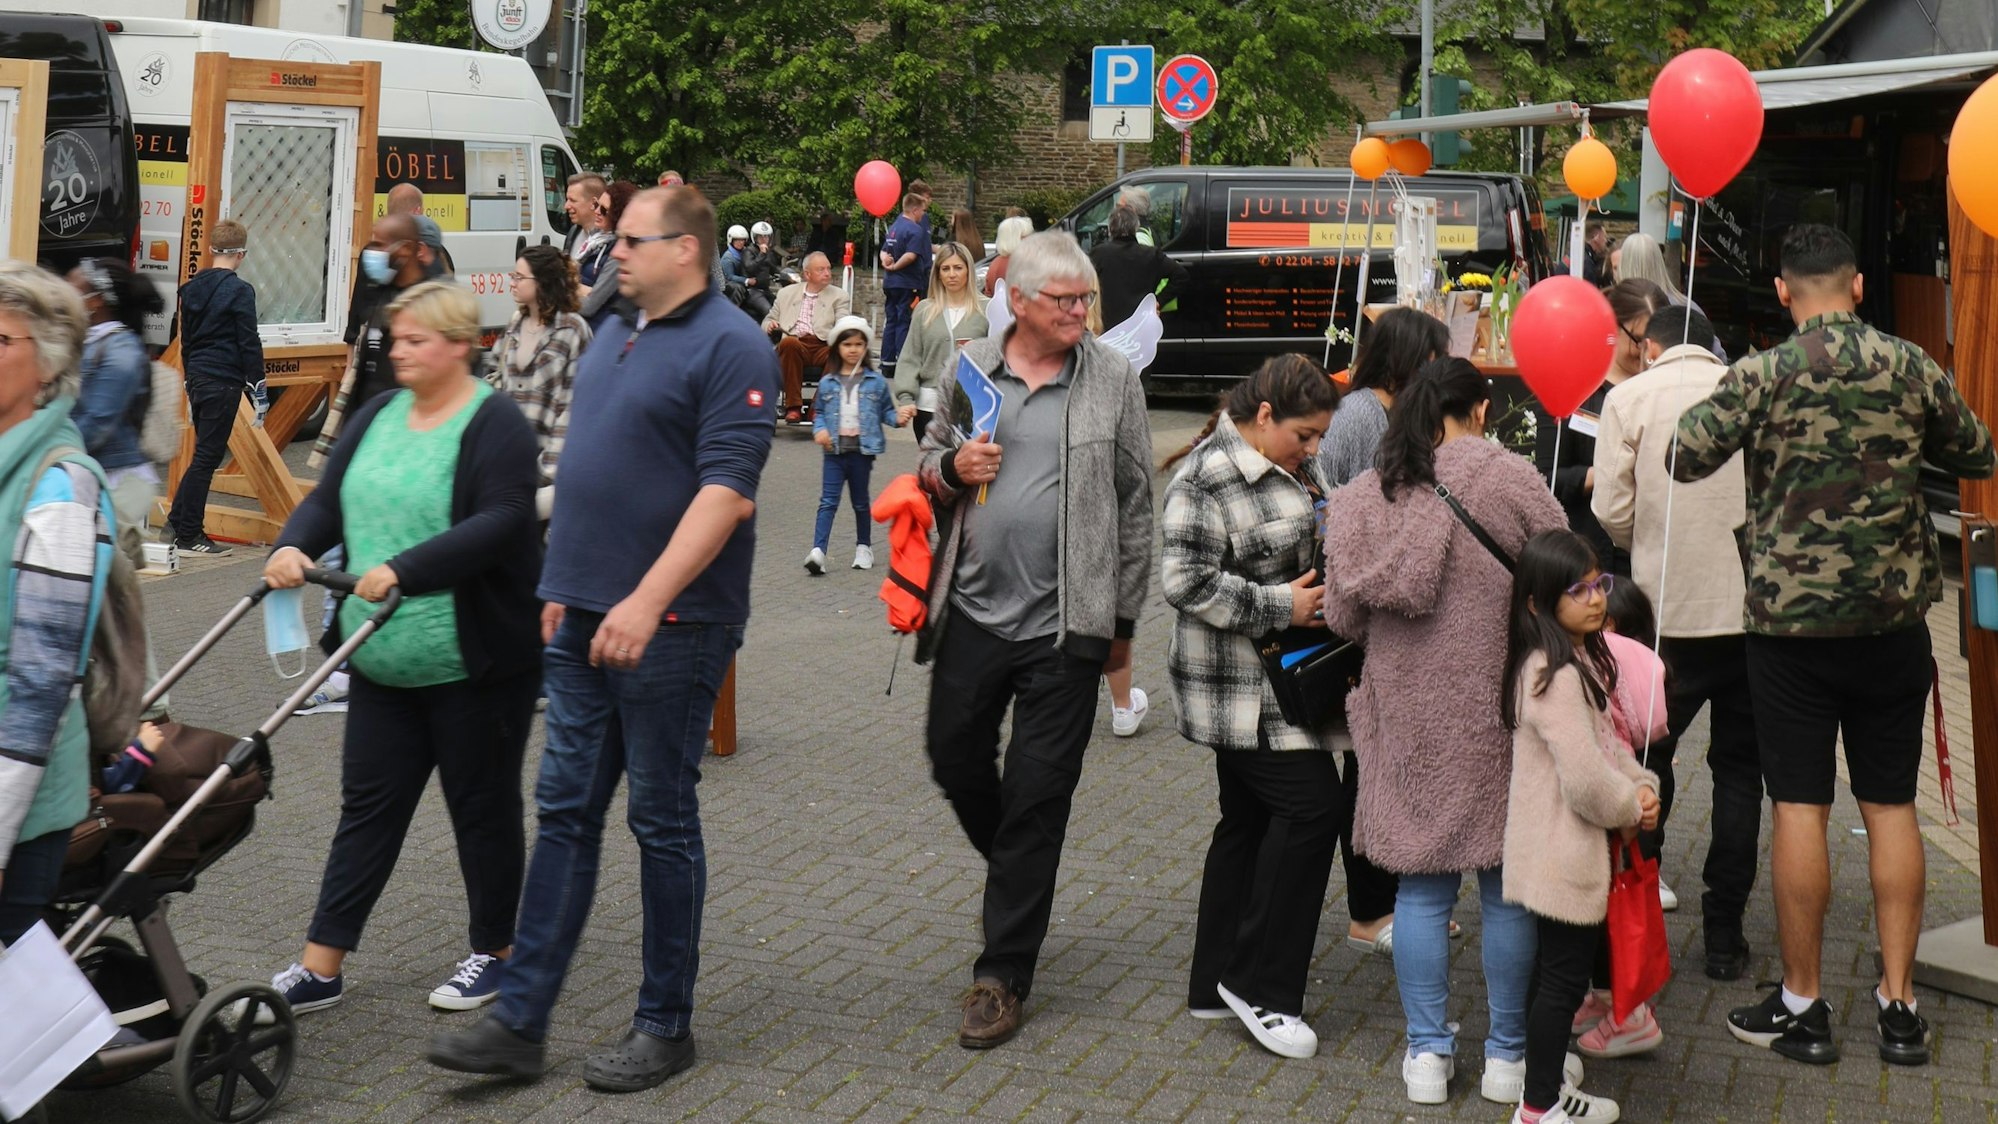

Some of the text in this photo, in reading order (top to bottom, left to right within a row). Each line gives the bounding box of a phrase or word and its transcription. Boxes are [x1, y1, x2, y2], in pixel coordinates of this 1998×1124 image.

[481, 22, 539, 46] Bundeskegelbahn
[140, 68, 162, 86] 20
[282, 73, 317, 87] Stöckel
[1106, 55, 1139, 104] P
[48, 172, 87, 212] 20
[156, 202, 172, 216] 70
[1240, 196, 1467, 219] JULIUS MÖEL
[59, 211, 87, 235] Jahre
[1321, 231, 1368, 242] kreativ
[1375, 233, 1383, 242] &
[1275, 255, 1283, 267] 0
[1285, 255, 1298, 267] 22
[1300, 255, 1313, 267] 04
[1323, 255, 1336, 267] 58
[471, 274, 485, 295] 58
[490, 273, 504, 294] 92
[265, 360, 300, 374] Stöckel
